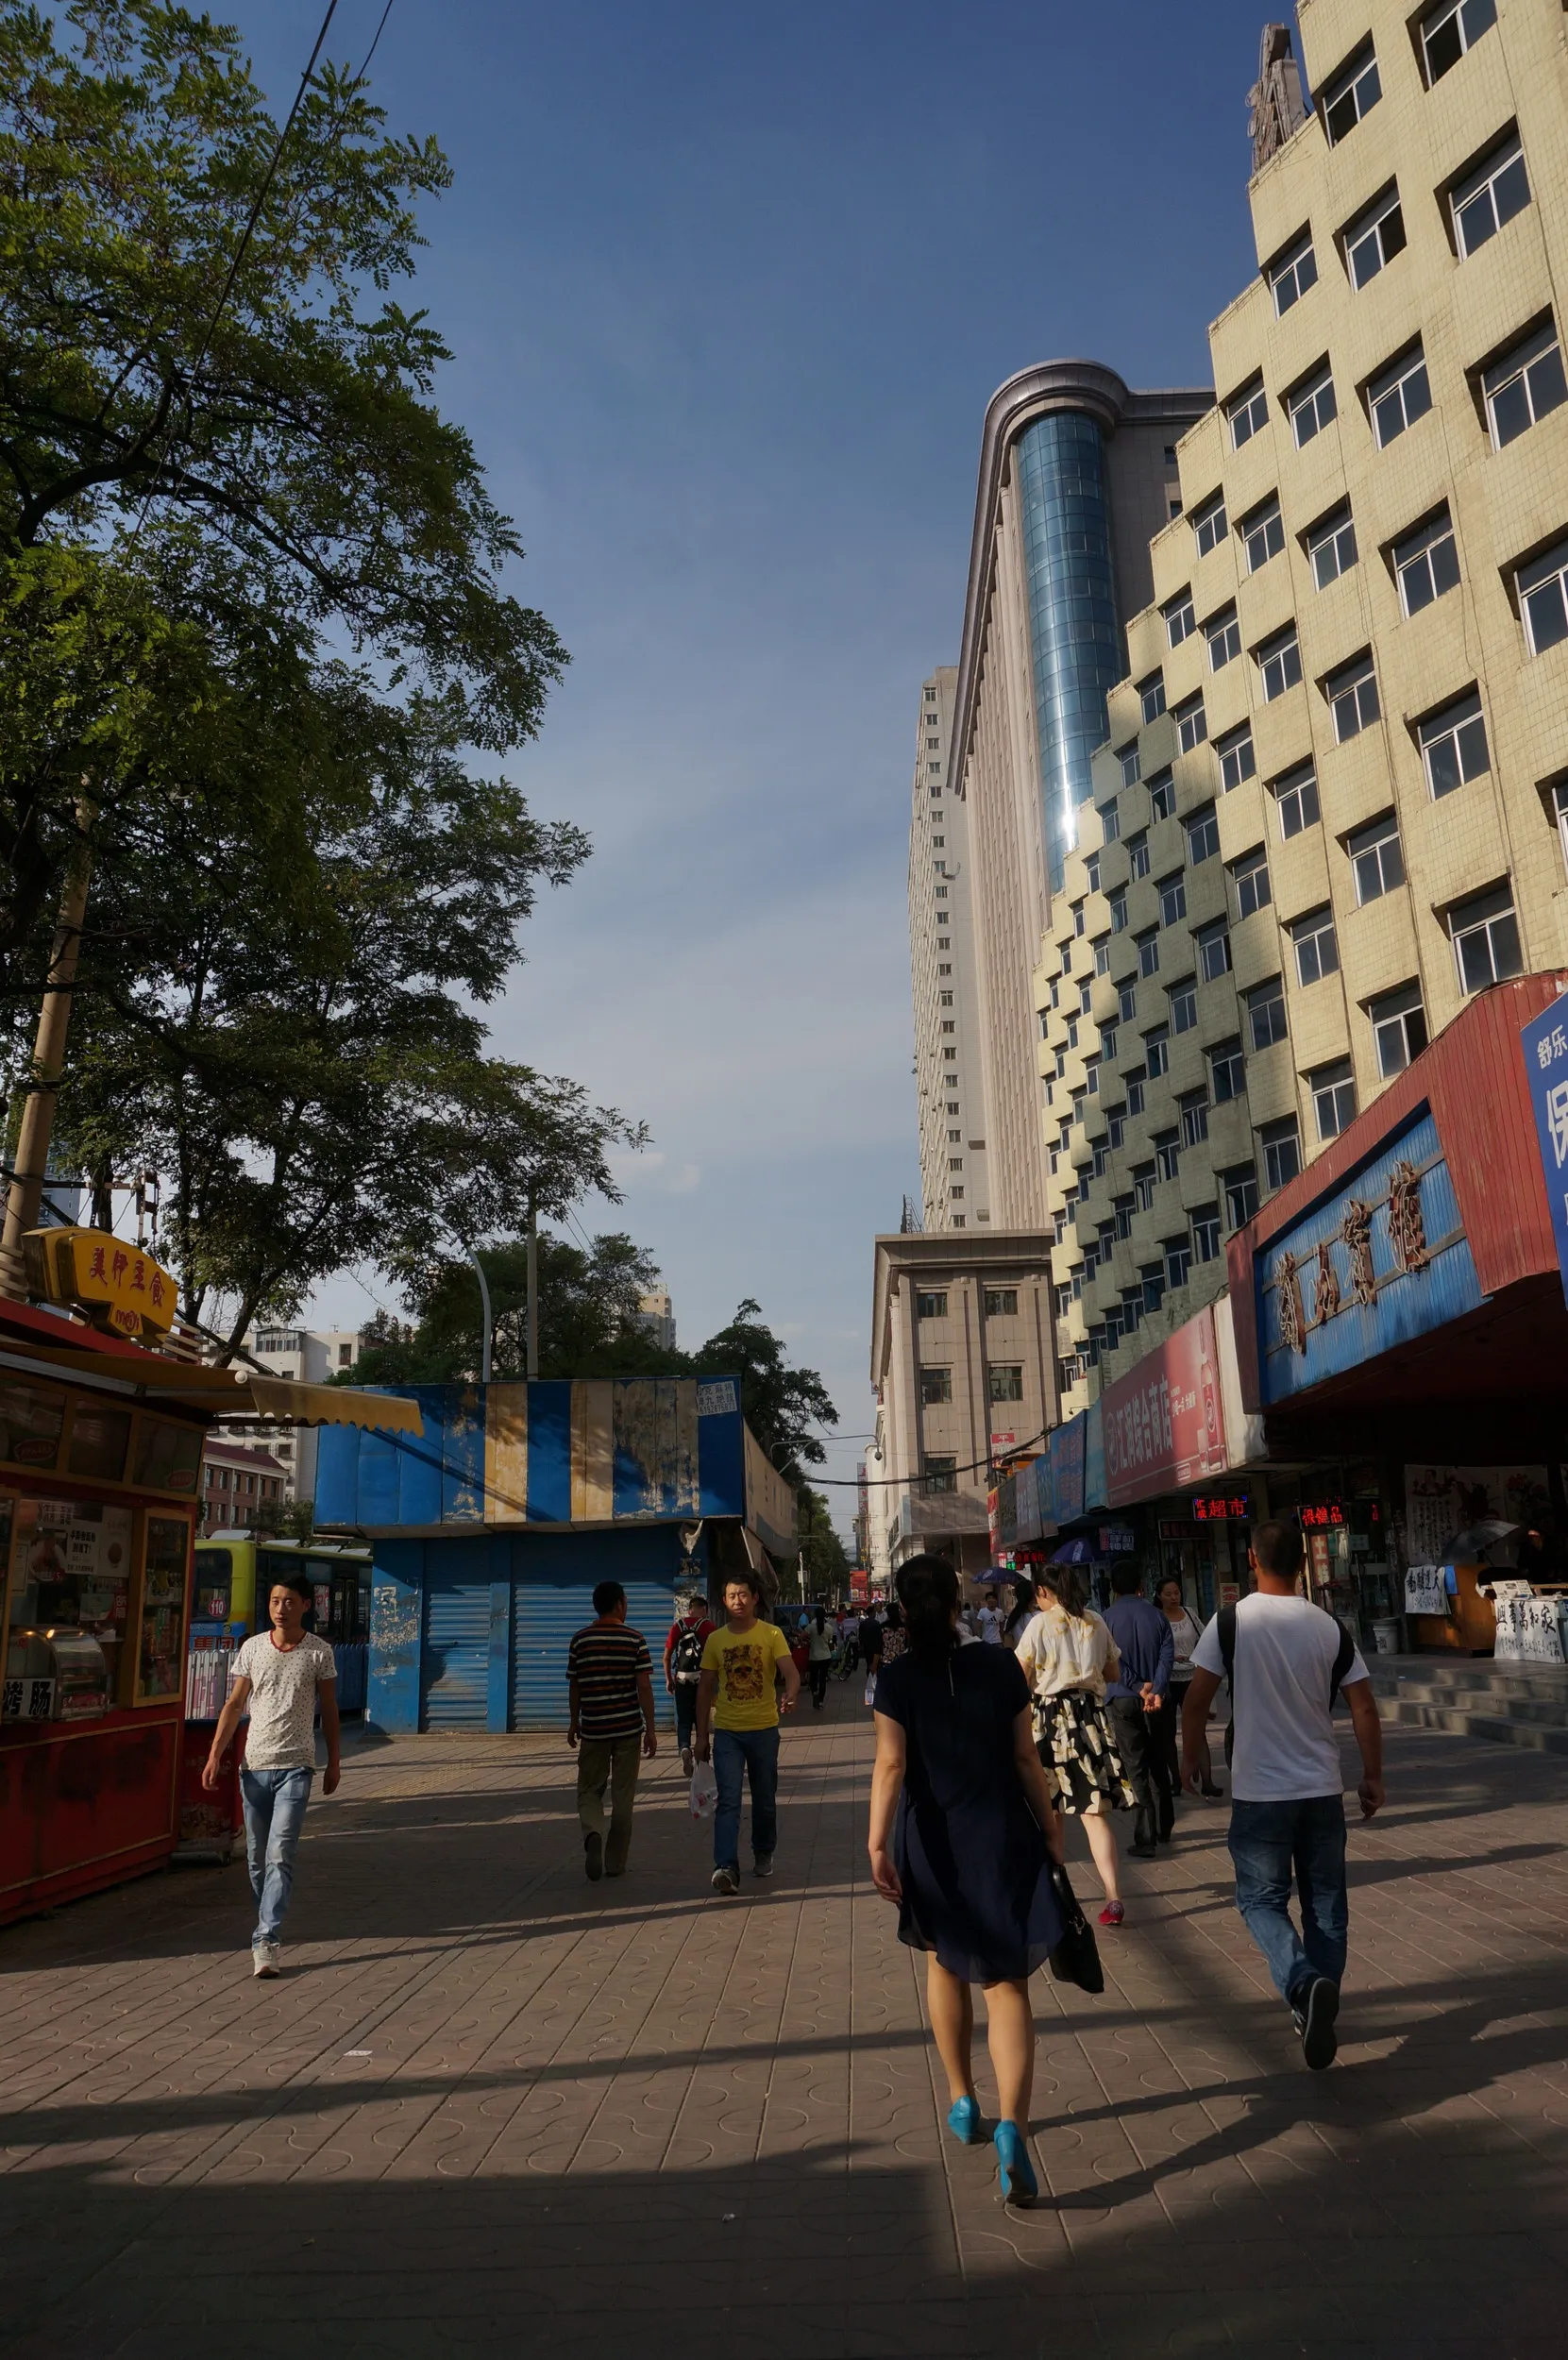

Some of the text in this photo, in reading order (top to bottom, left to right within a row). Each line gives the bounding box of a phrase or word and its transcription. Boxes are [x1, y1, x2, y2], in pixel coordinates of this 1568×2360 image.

[89, 1246, 165, 1308] 美伊主食
[211, 1600, 225, 1615] 110
